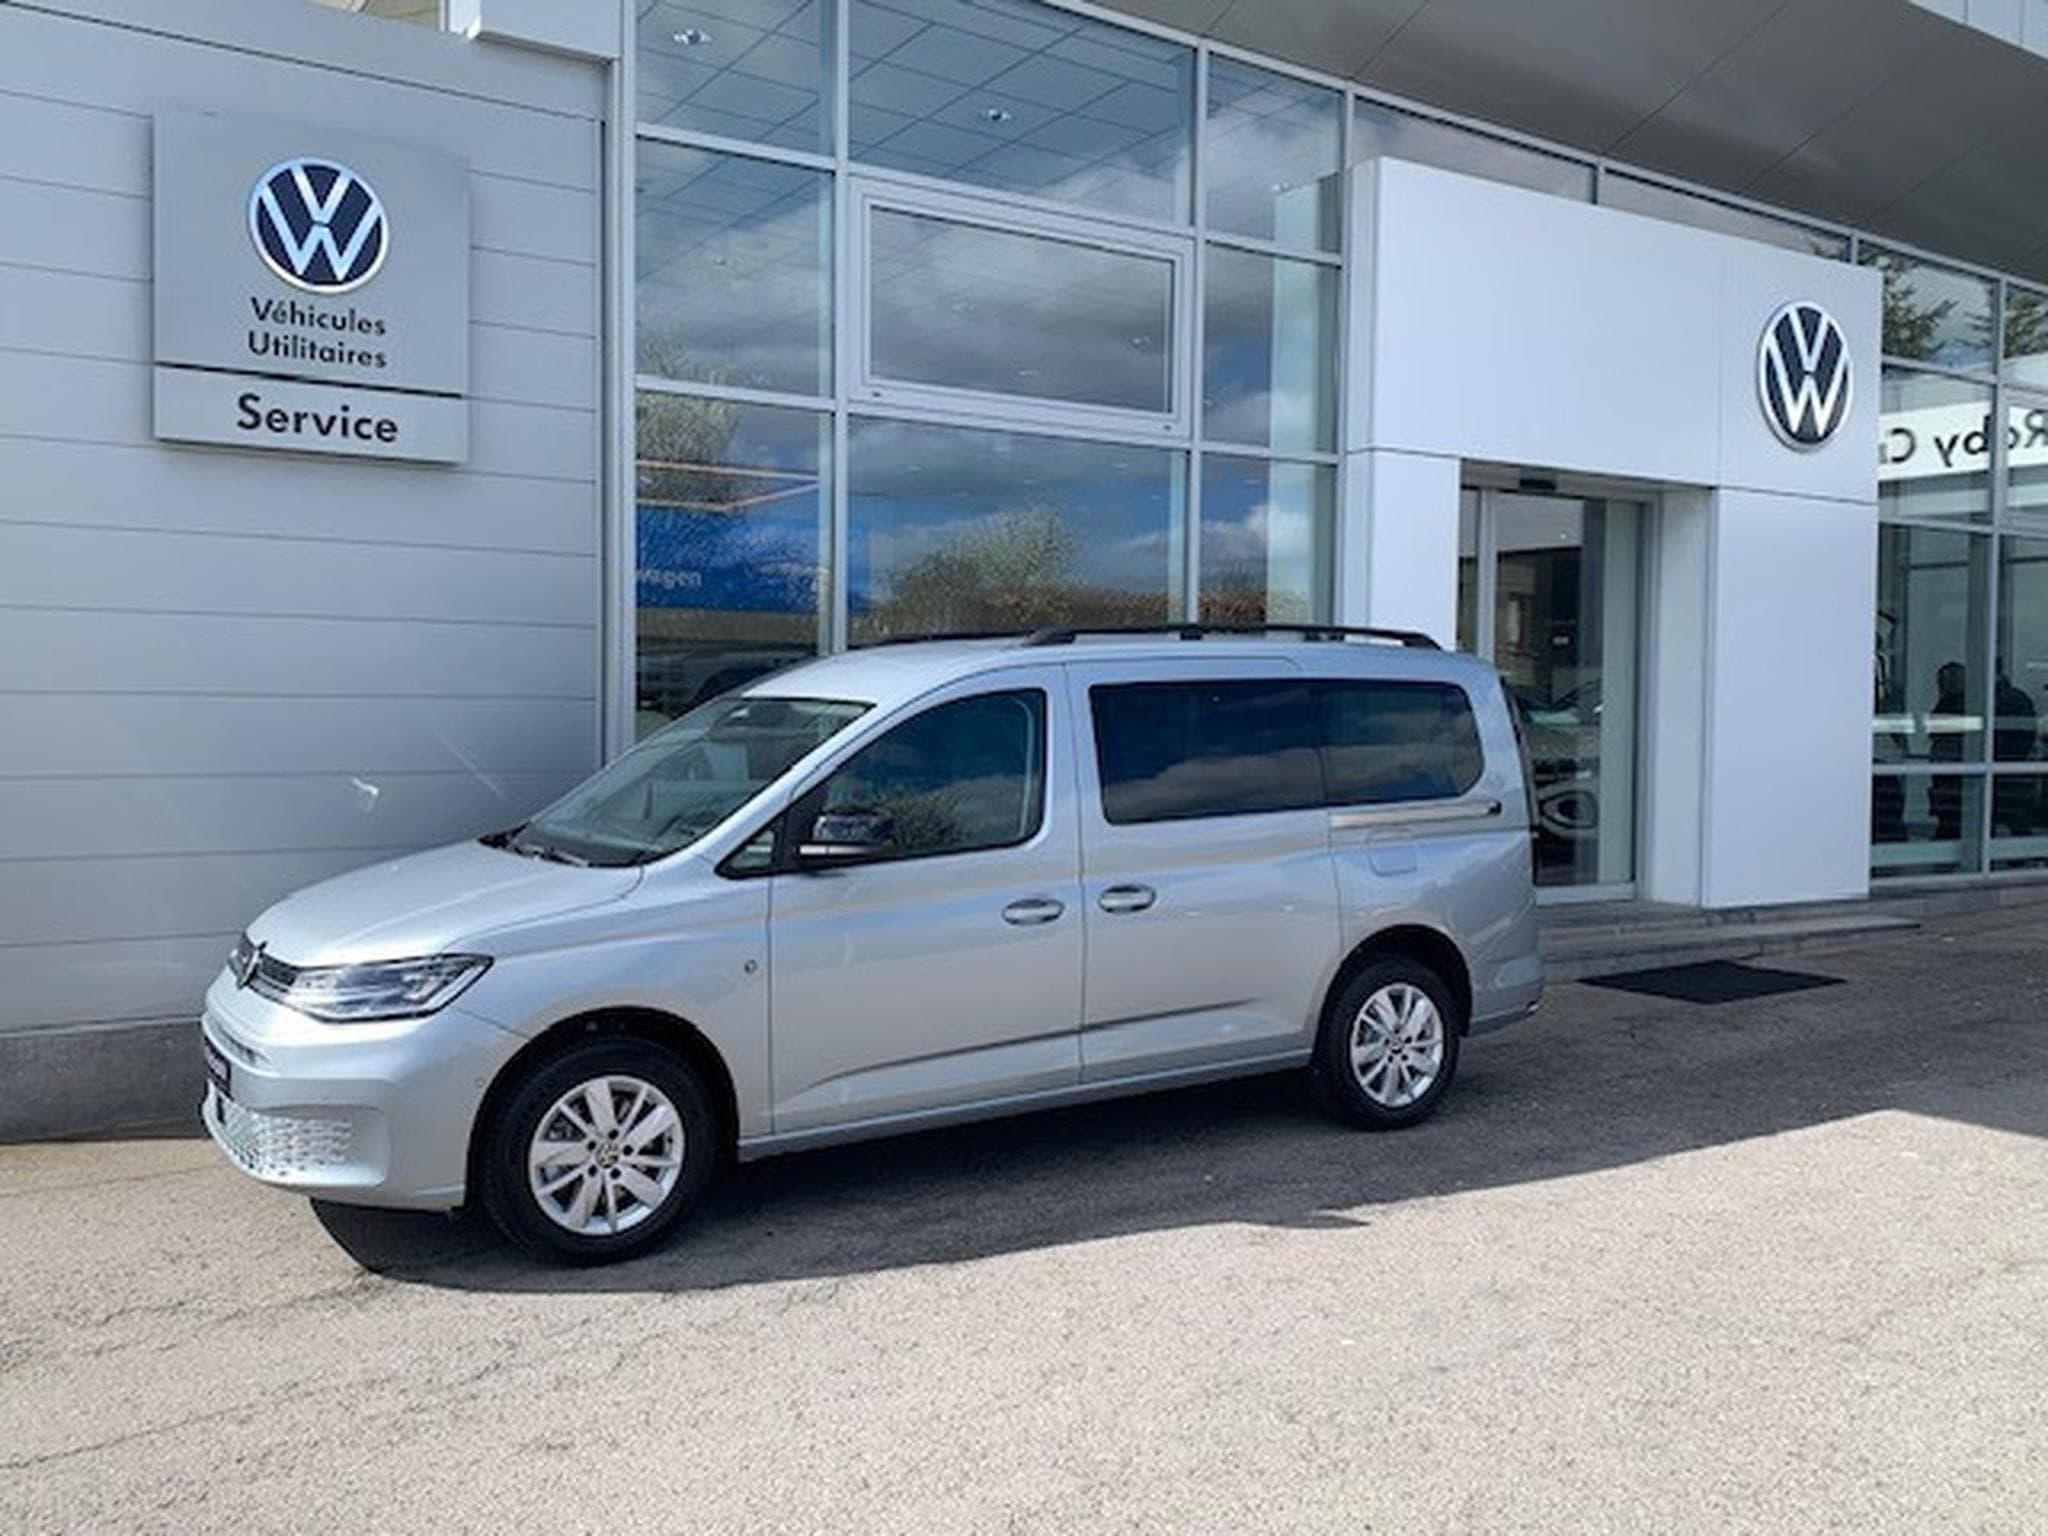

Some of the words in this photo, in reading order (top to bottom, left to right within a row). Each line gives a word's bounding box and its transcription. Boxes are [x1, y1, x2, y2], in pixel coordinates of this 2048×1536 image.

[251, 296, 386, 336] Véhicules
[248, 330, 387, 369] Utilitaires
[236, 393, 398, 443] Service
